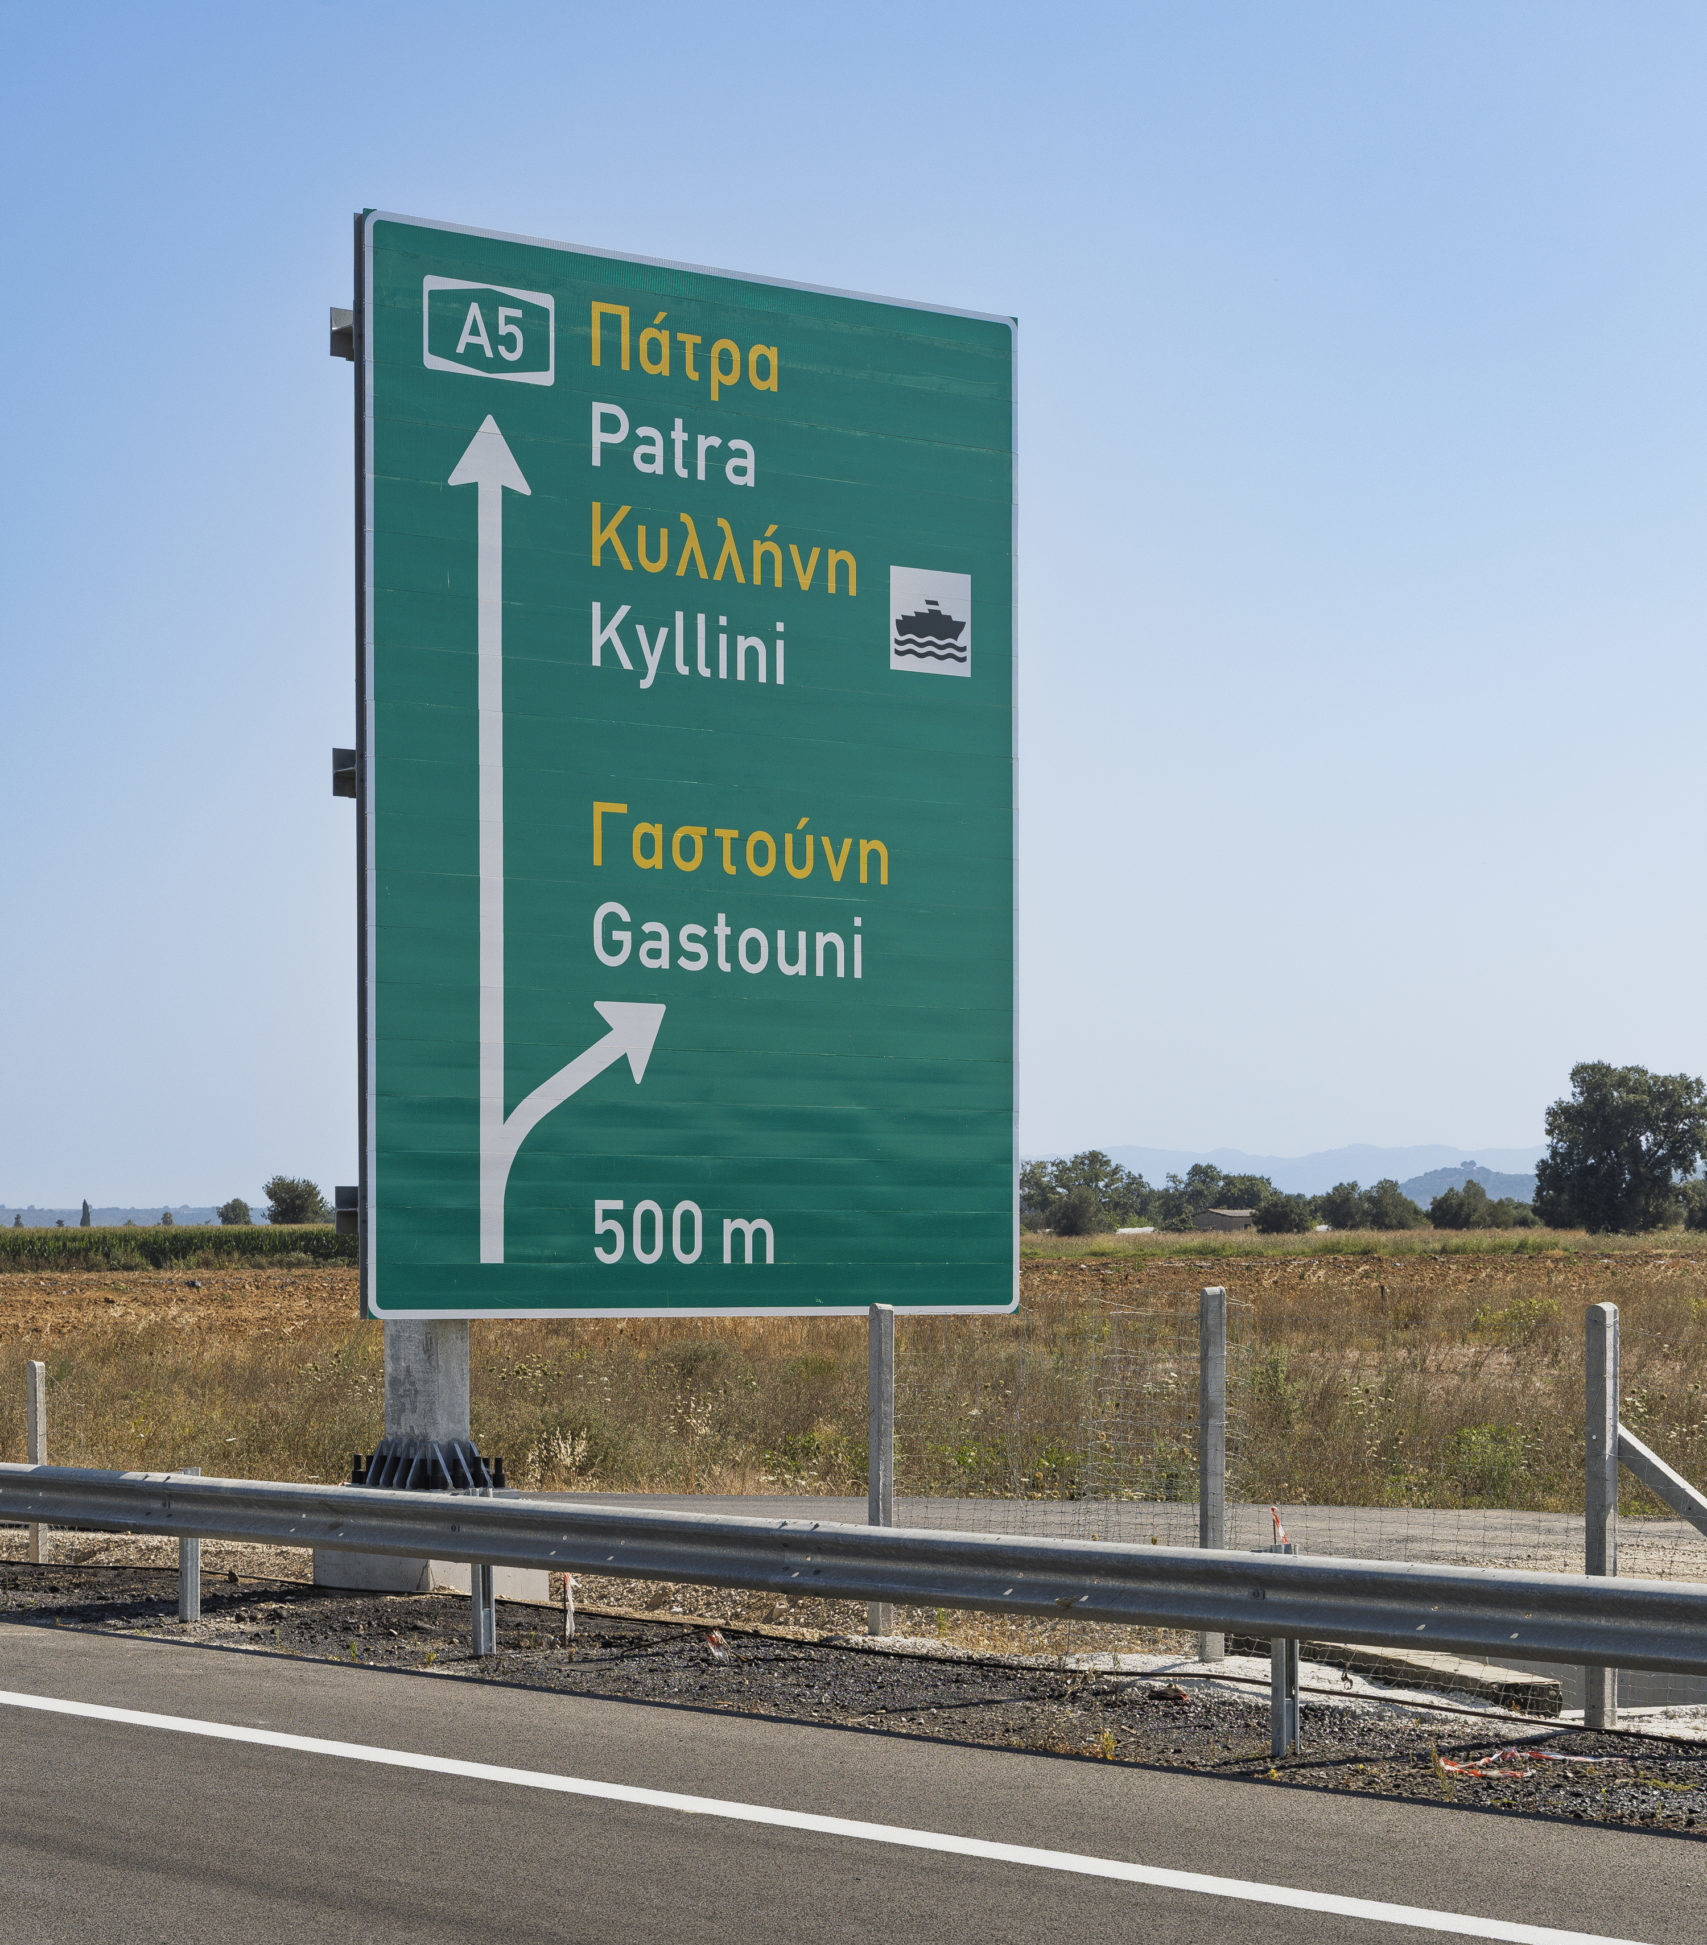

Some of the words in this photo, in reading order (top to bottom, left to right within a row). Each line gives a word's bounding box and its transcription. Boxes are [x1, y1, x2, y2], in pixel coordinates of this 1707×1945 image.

[455, 301, 524, 362] A5
[591, 300, 779, 402] Πάτρα
[591, 401, 756, 488] Patra
[591, 501, 858, 597] Κυλλήνη
[591, 601, 786, 690] Kyllini
[592, 801, 889, 885] Γαστούνη
[593, 901, 863, 979] Gastouni
[594, 1199, 703, 1265] 500
[723, 1218, 775, 1265] m
